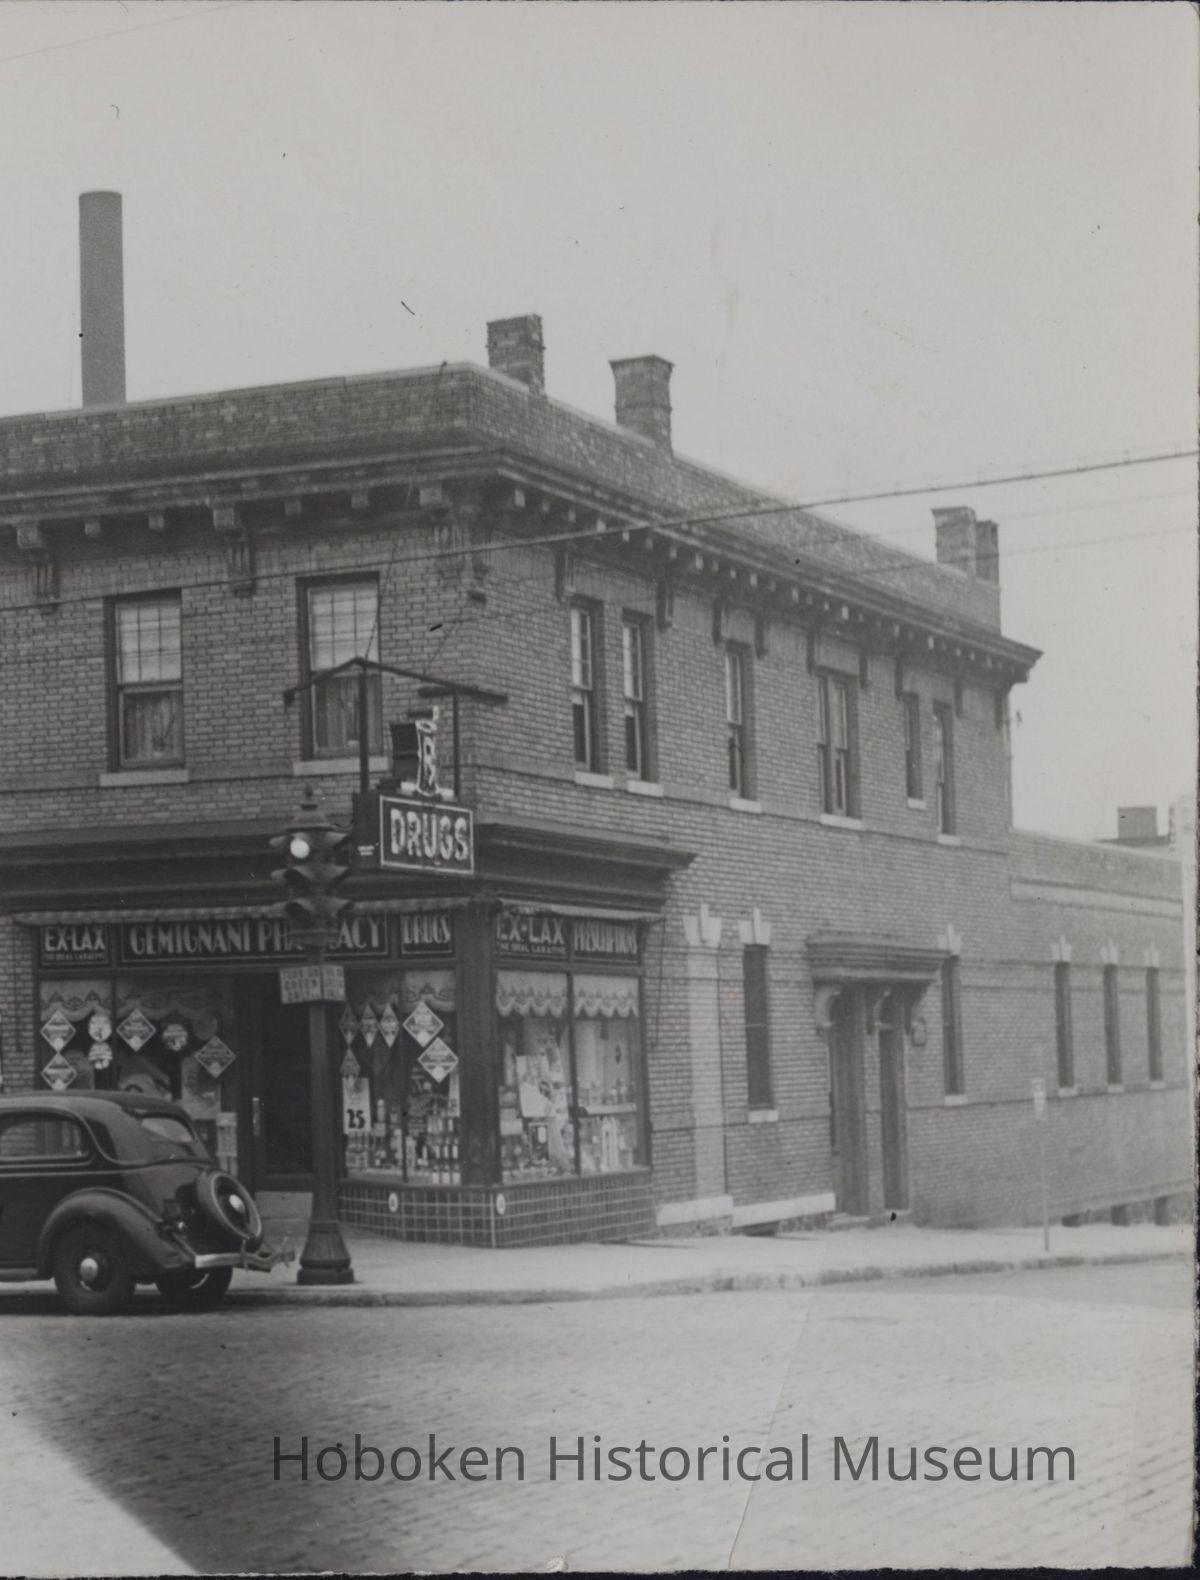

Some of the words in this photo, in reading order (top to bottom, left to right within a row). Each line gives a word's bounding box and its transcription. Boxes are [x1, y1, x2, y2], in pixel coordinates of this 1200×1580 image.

[390, 808, 468, 860] DRUGS
[130, 922, 251, 954] GEMIGNANI
[258, 918, 381, 951] PHACY
[403, 914, 452, 944] DRUGS
